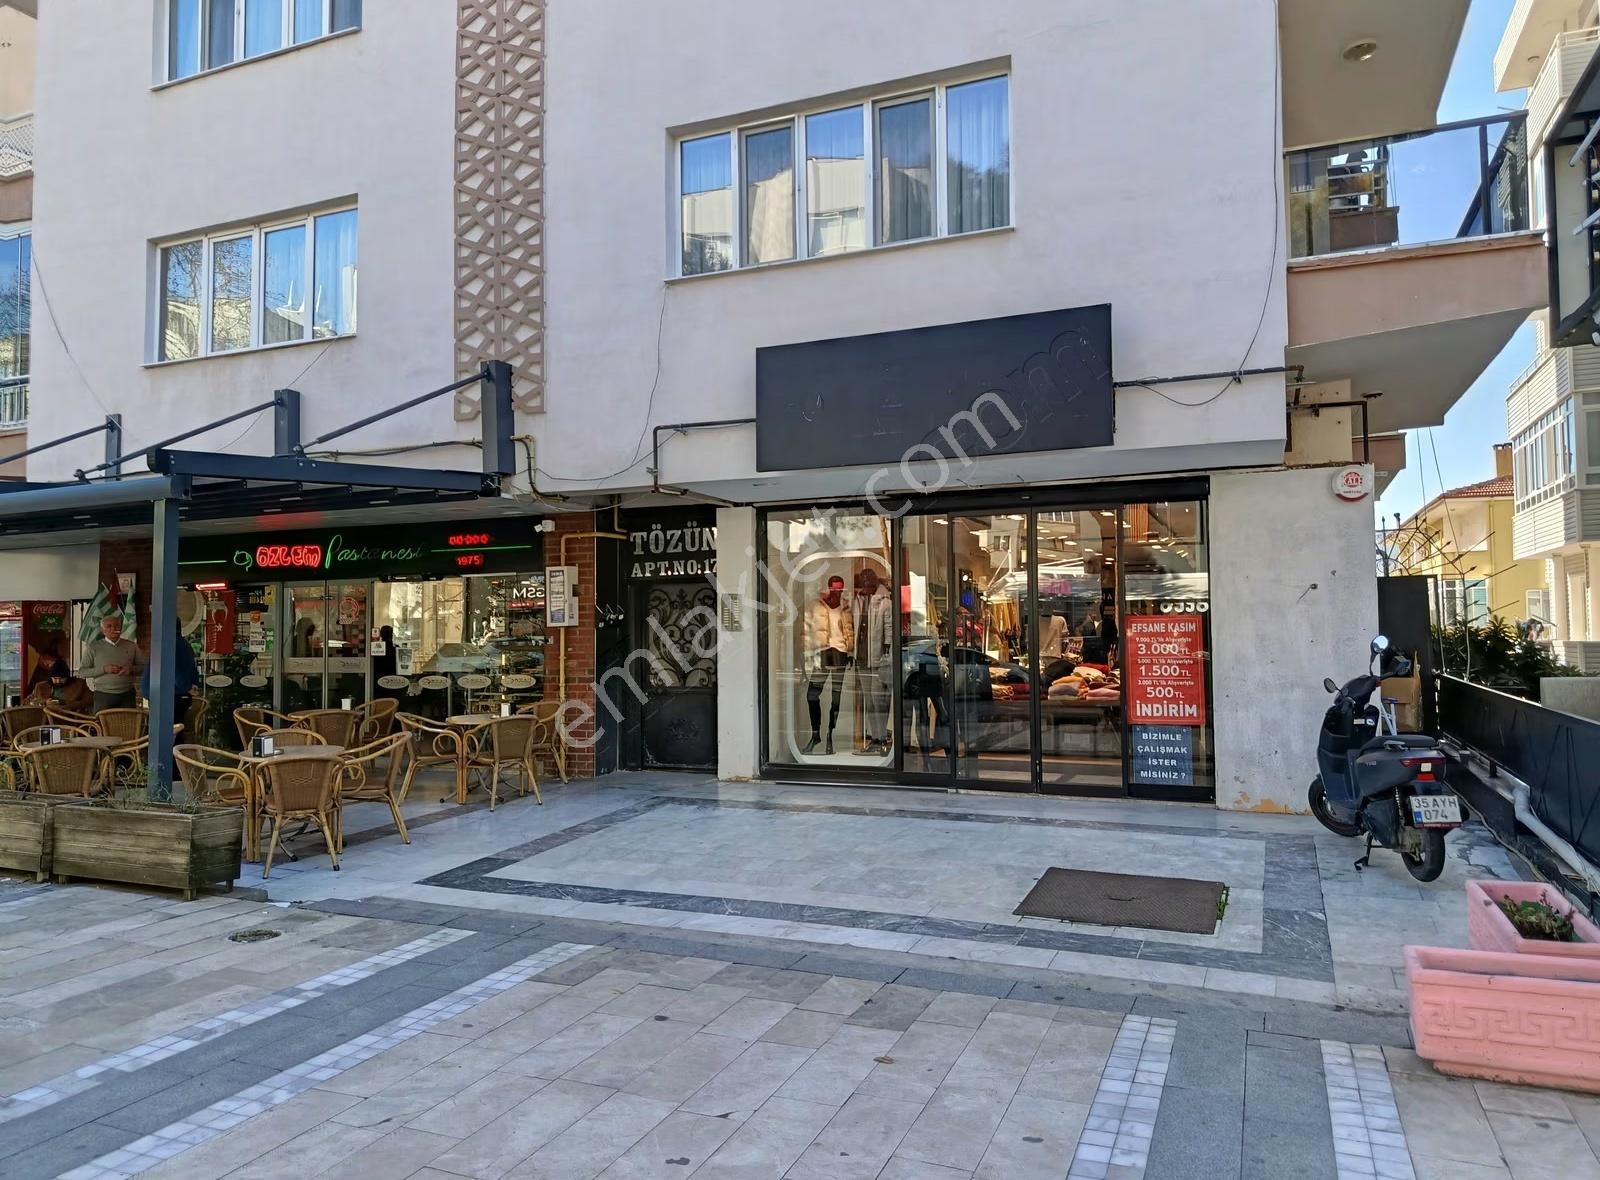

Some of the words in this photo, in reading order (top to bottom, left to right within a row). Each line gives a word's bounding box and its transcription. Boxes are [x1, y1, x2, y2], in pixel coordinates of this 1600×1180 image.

[457, 555, 481, 566] 1975
[1131, 623, 1166, 633] EFSANE
[1168, 622, 1196, 632] KASIM
[1138, 644, 1179, 655] 3.000
[1139, 665, 1180, 676] 1.500
[1146, 686, 1174, 698] 500
[1136, 700, 1197, 717] İNDİRİM
[1142, 732, 1182, 741] BİZİMLE
[1137, 745, 1188, 755] ÇALIŞMAK
[1148, 757, 1177, 766] İSTER
[1414, 797, 1430, 809] 35
[1432, 797, 1458, 809] AYH
[1424, 809, 1449, 821] 074
